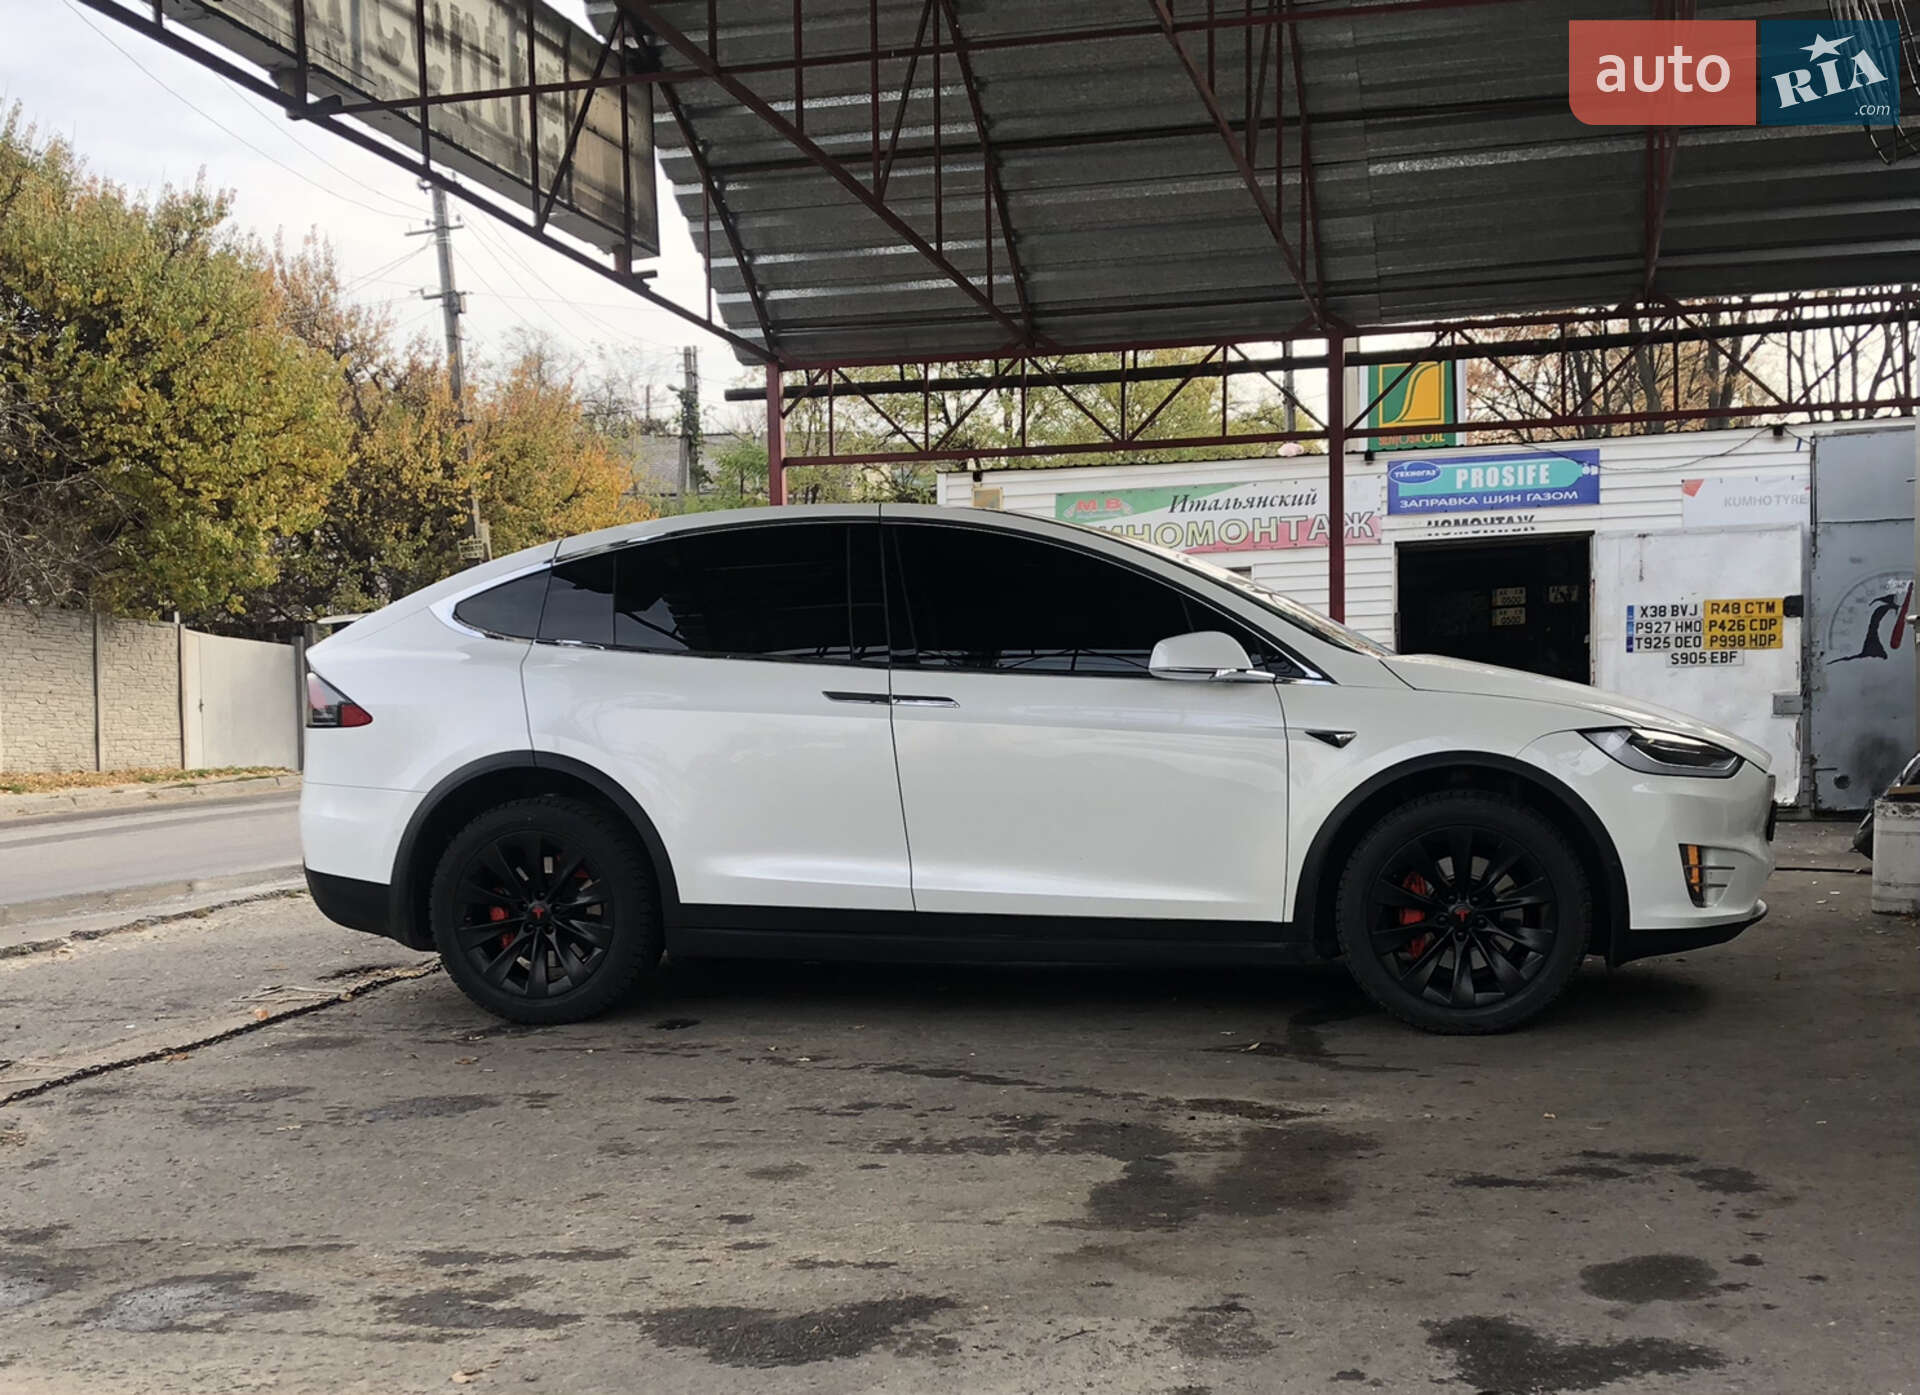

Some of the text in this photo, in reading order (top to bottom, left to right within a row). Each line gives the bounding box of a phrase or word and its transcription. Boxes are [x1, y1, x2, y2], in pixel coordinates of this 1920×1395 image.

[1455, 464, 1550, 489] PROSIFE
[1168, 488, 1318, 513] Итальянский
[1399, 490, 1578, 509] ЗАПРАВКА ШИН ГАЗОМ
[1724, 494, 1809, 507] KUMHO TYRE
[1640, 604, 1698, 618] X38 BVJ
[1711, 601, 1775, 615] R48 CTM
[1636, 621, 1671, 634] P927
[1708, 618, 1777, 632] P426 CDP
[1635, 637, 1671, 650] T925
[1710, 634, 1777, 647] P998 HDP
[1671, 651, 1738, 665] S905 EBF
